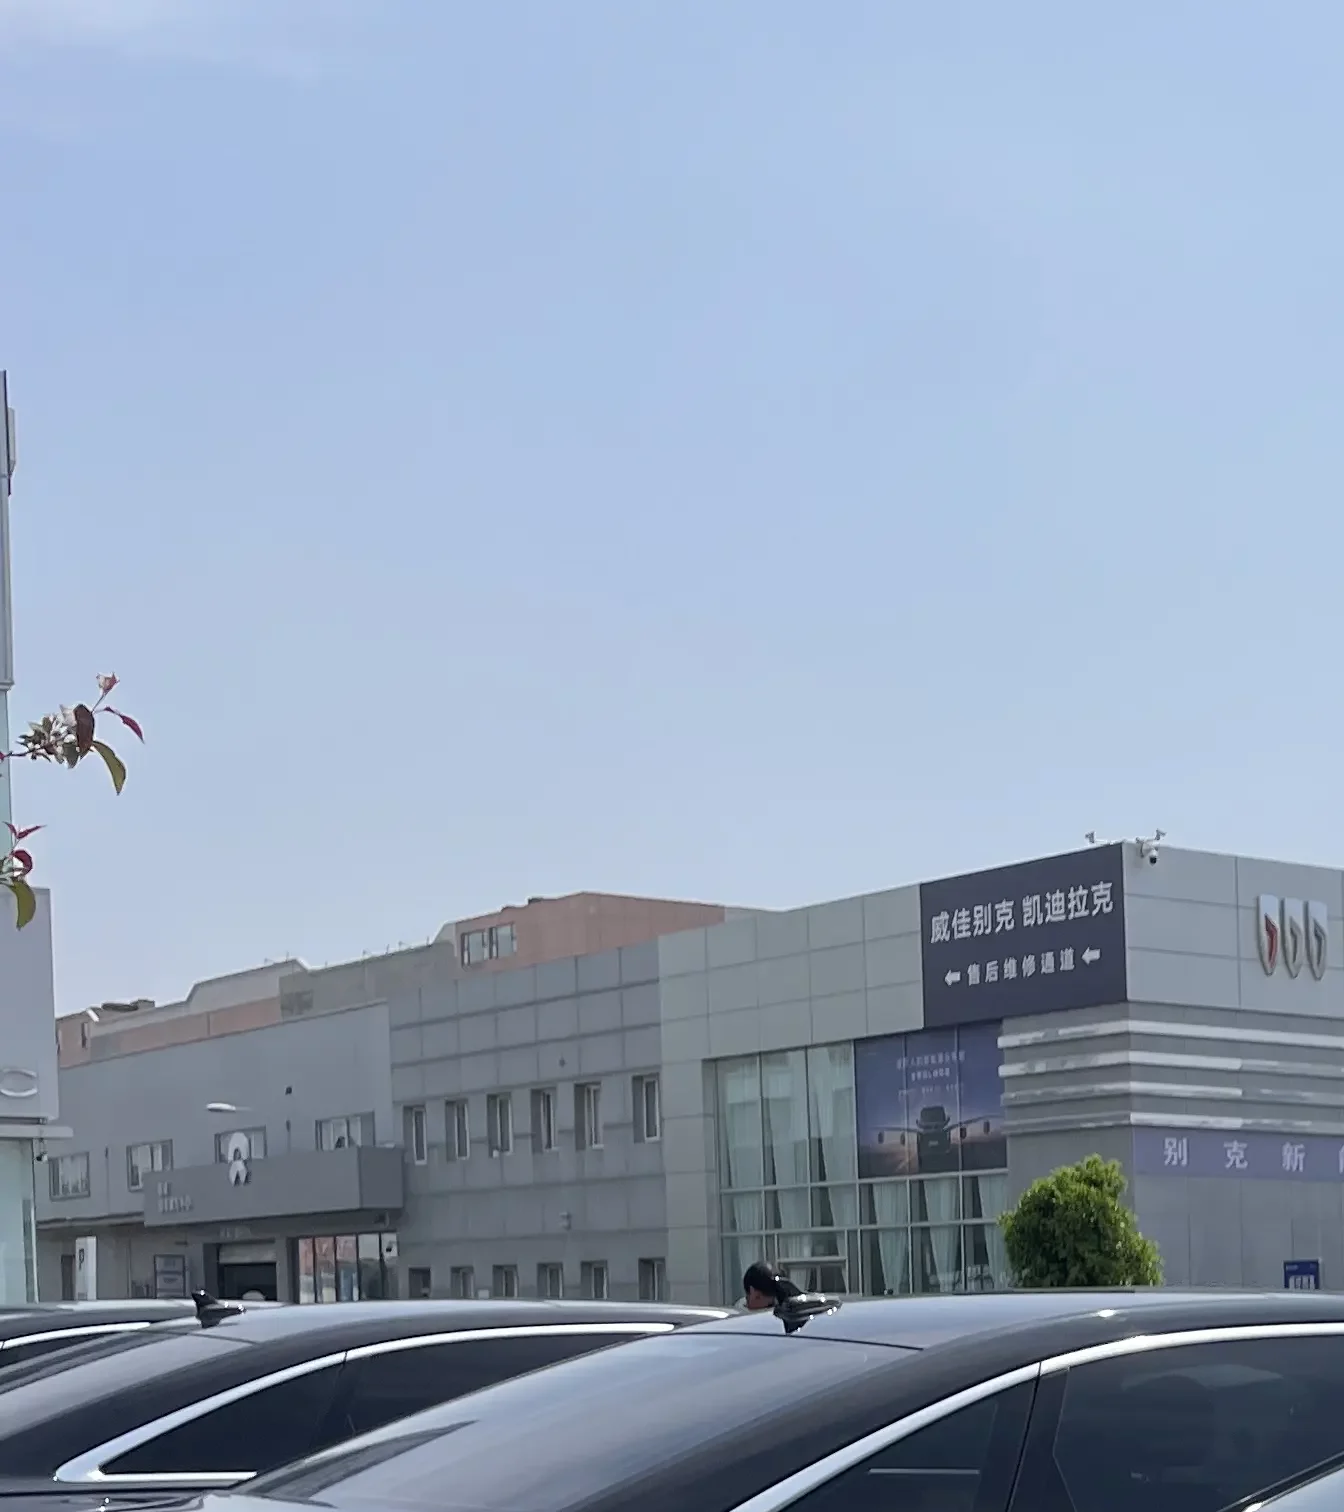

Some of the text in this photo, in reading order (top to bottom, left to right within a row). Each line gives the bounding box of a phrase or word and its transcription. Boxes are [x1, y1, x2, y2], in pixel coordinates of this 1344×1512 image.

[930, 880, 1114, 944] 威佳别克 凯迪拉克
[967, 946, 1075, 986] 售后维修通道
